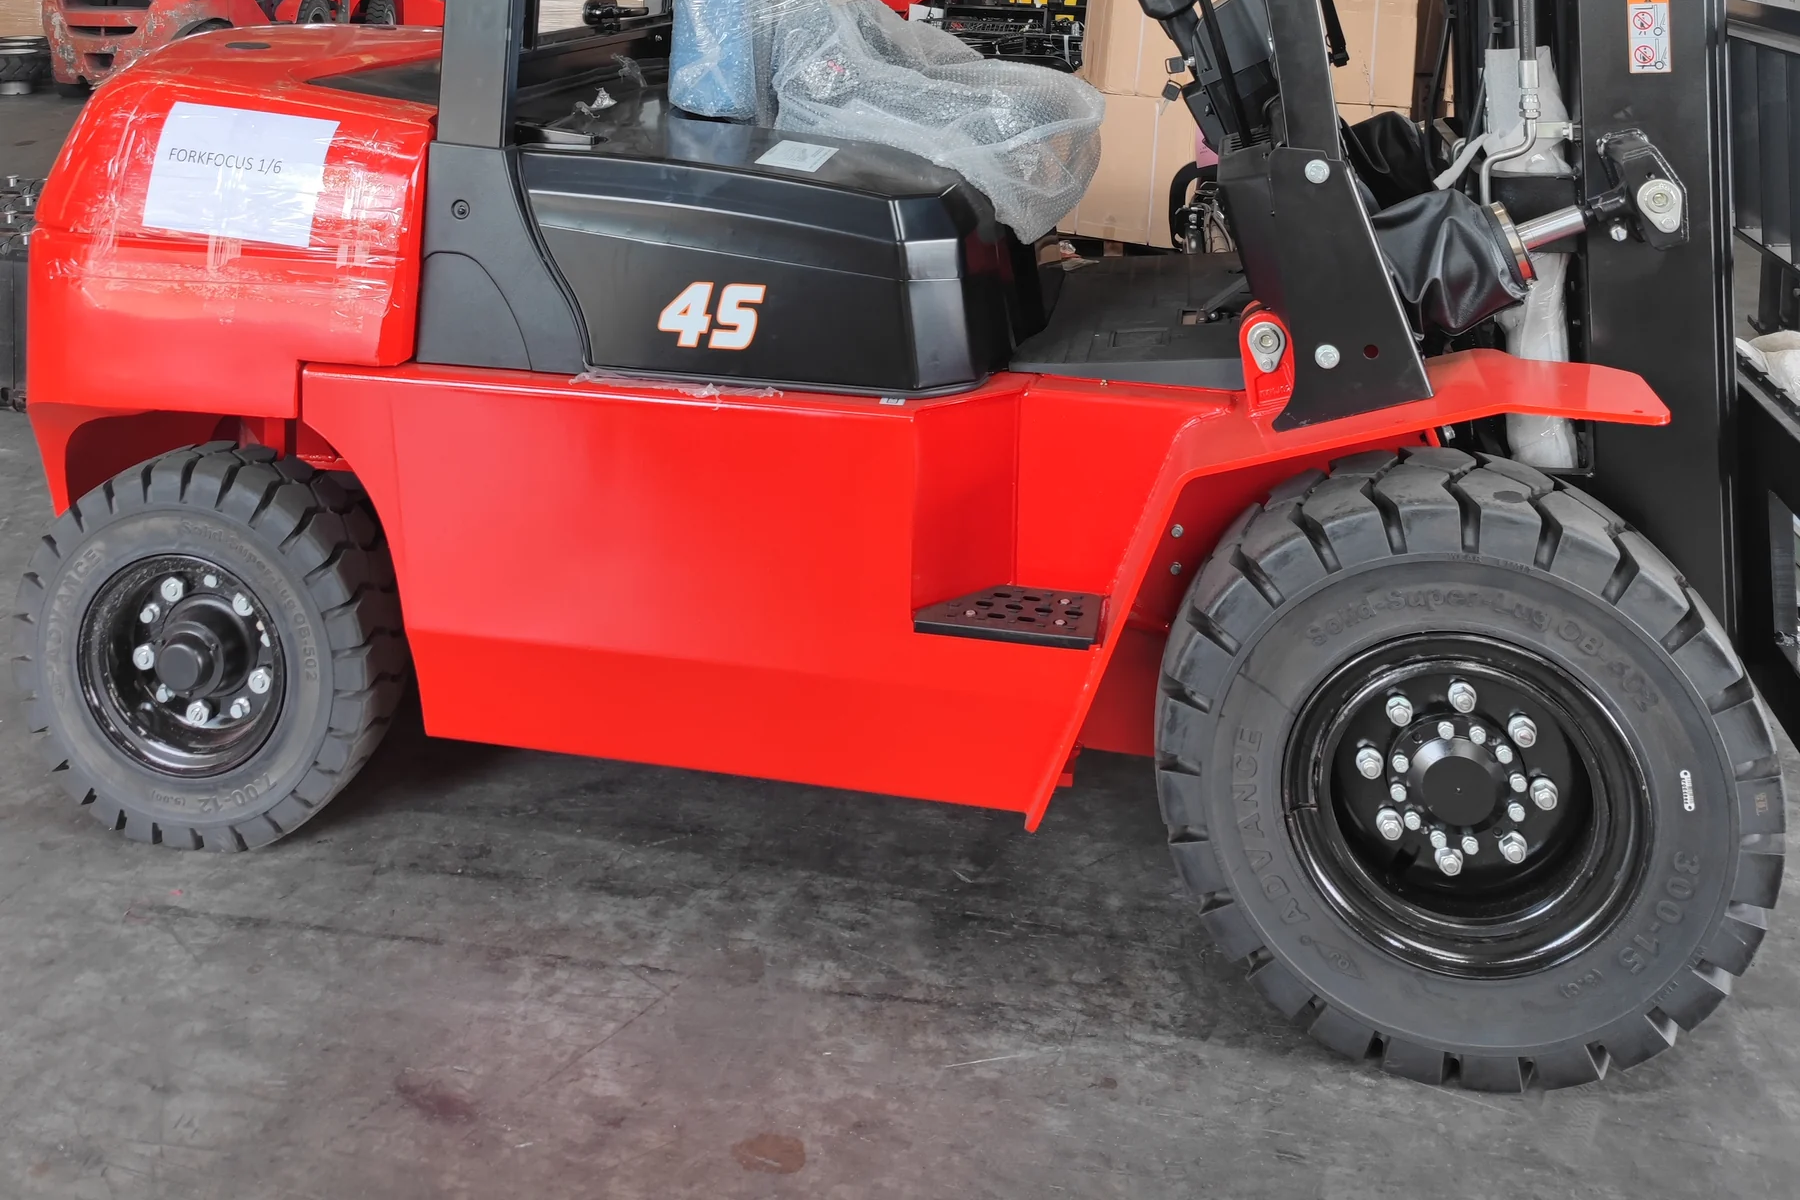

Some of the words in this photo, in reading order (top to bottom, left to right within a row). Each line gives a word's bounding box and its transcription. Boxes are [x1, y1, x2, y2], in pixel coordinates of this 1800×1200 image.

[168, 147, 255, 171] FORKFOCUS
[257, 158, 283, 175] 1/6
[46, 548, 102, 675] ADVANCE
[1231, 727, 1322, 927] ADVANCE
[1617, 850, 1701, 976] 300-15
